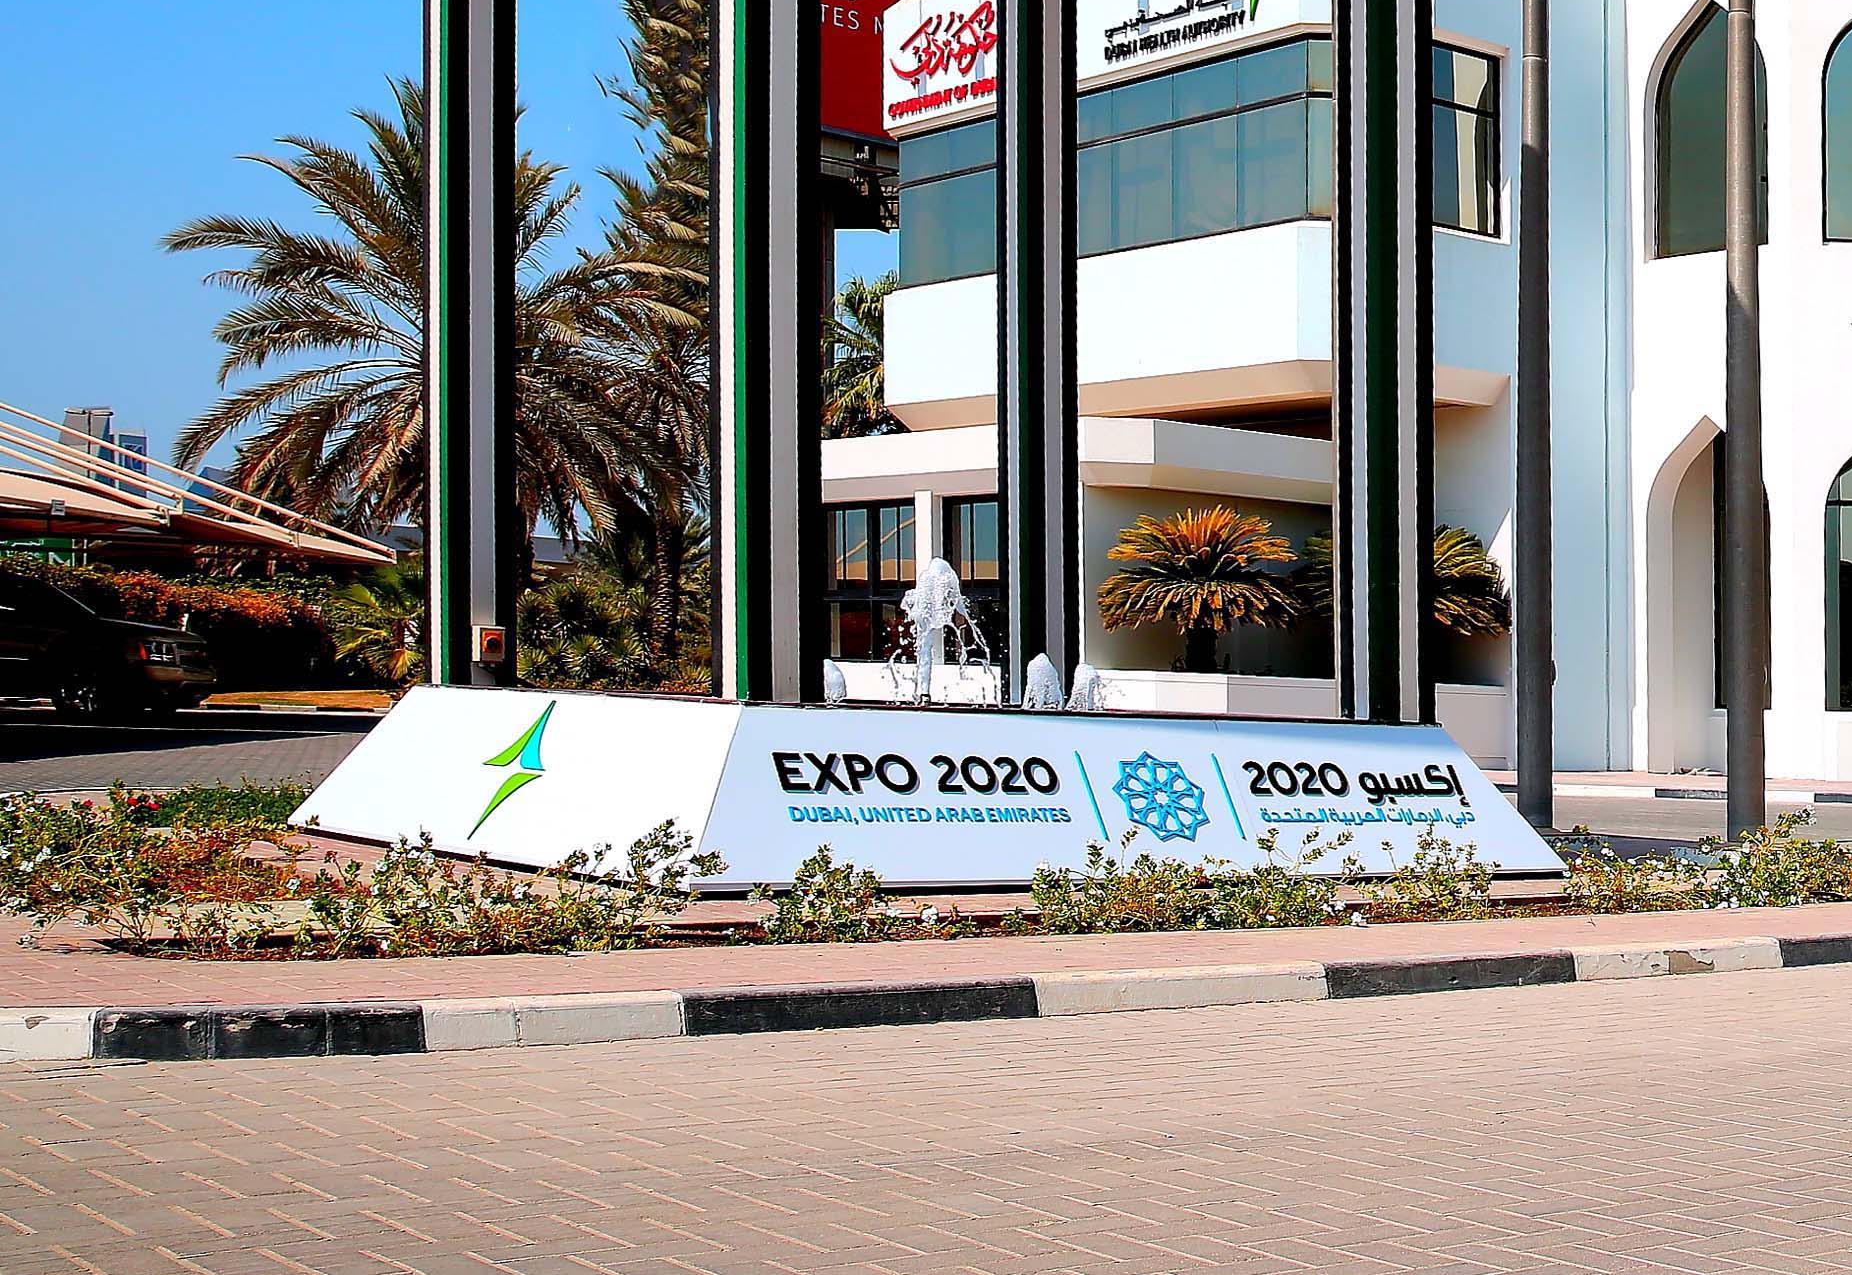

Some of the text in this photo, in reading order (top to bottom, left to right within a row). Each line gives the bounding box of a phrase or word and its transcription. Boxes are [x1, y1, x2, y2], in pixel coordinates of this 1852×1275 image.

[820, 4, 860, 30] TES
[772, 752, 1062, 795] EXPO 2020
[1242, 761, 1471, 807] إكسبو 2020
[788, 806, 1072, 825] DUBAI, UNITED ARAB EMIRATES
[1259, 807, 1329, 823] المتحدة
[1328, 807, 1387, 825] العربية
